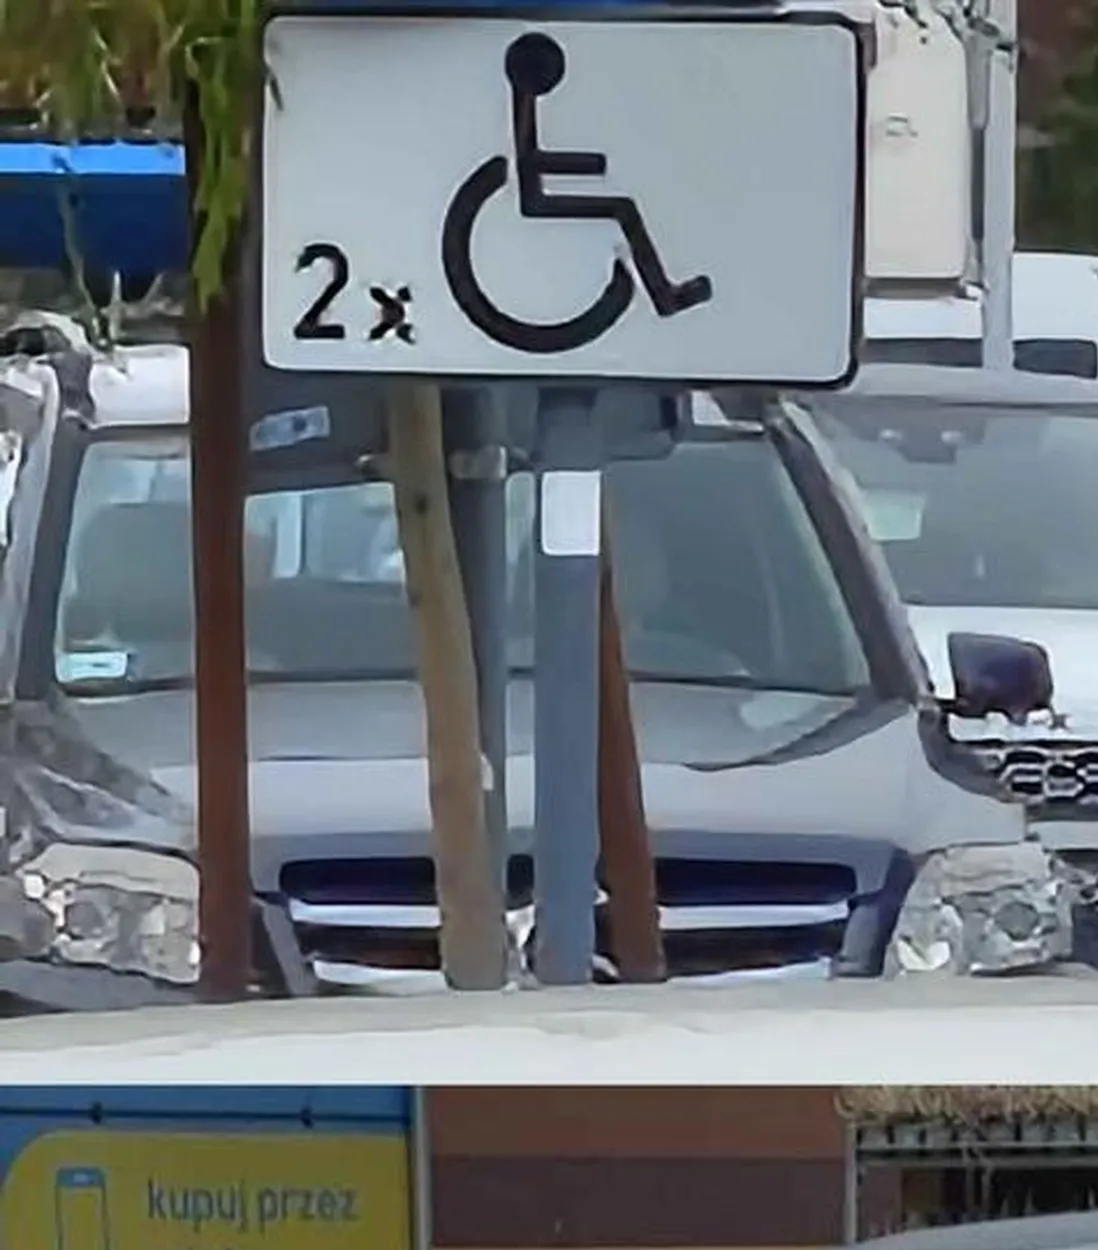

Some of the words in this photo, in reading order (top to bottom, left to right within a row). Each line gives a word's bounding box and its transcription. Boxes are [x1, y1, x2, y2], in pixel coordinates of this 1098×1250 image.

[293, 243, 416, 344] 2x
[146, 1177, 248, 1234] kupuj
[258, 1184, 360, 1237] przez
